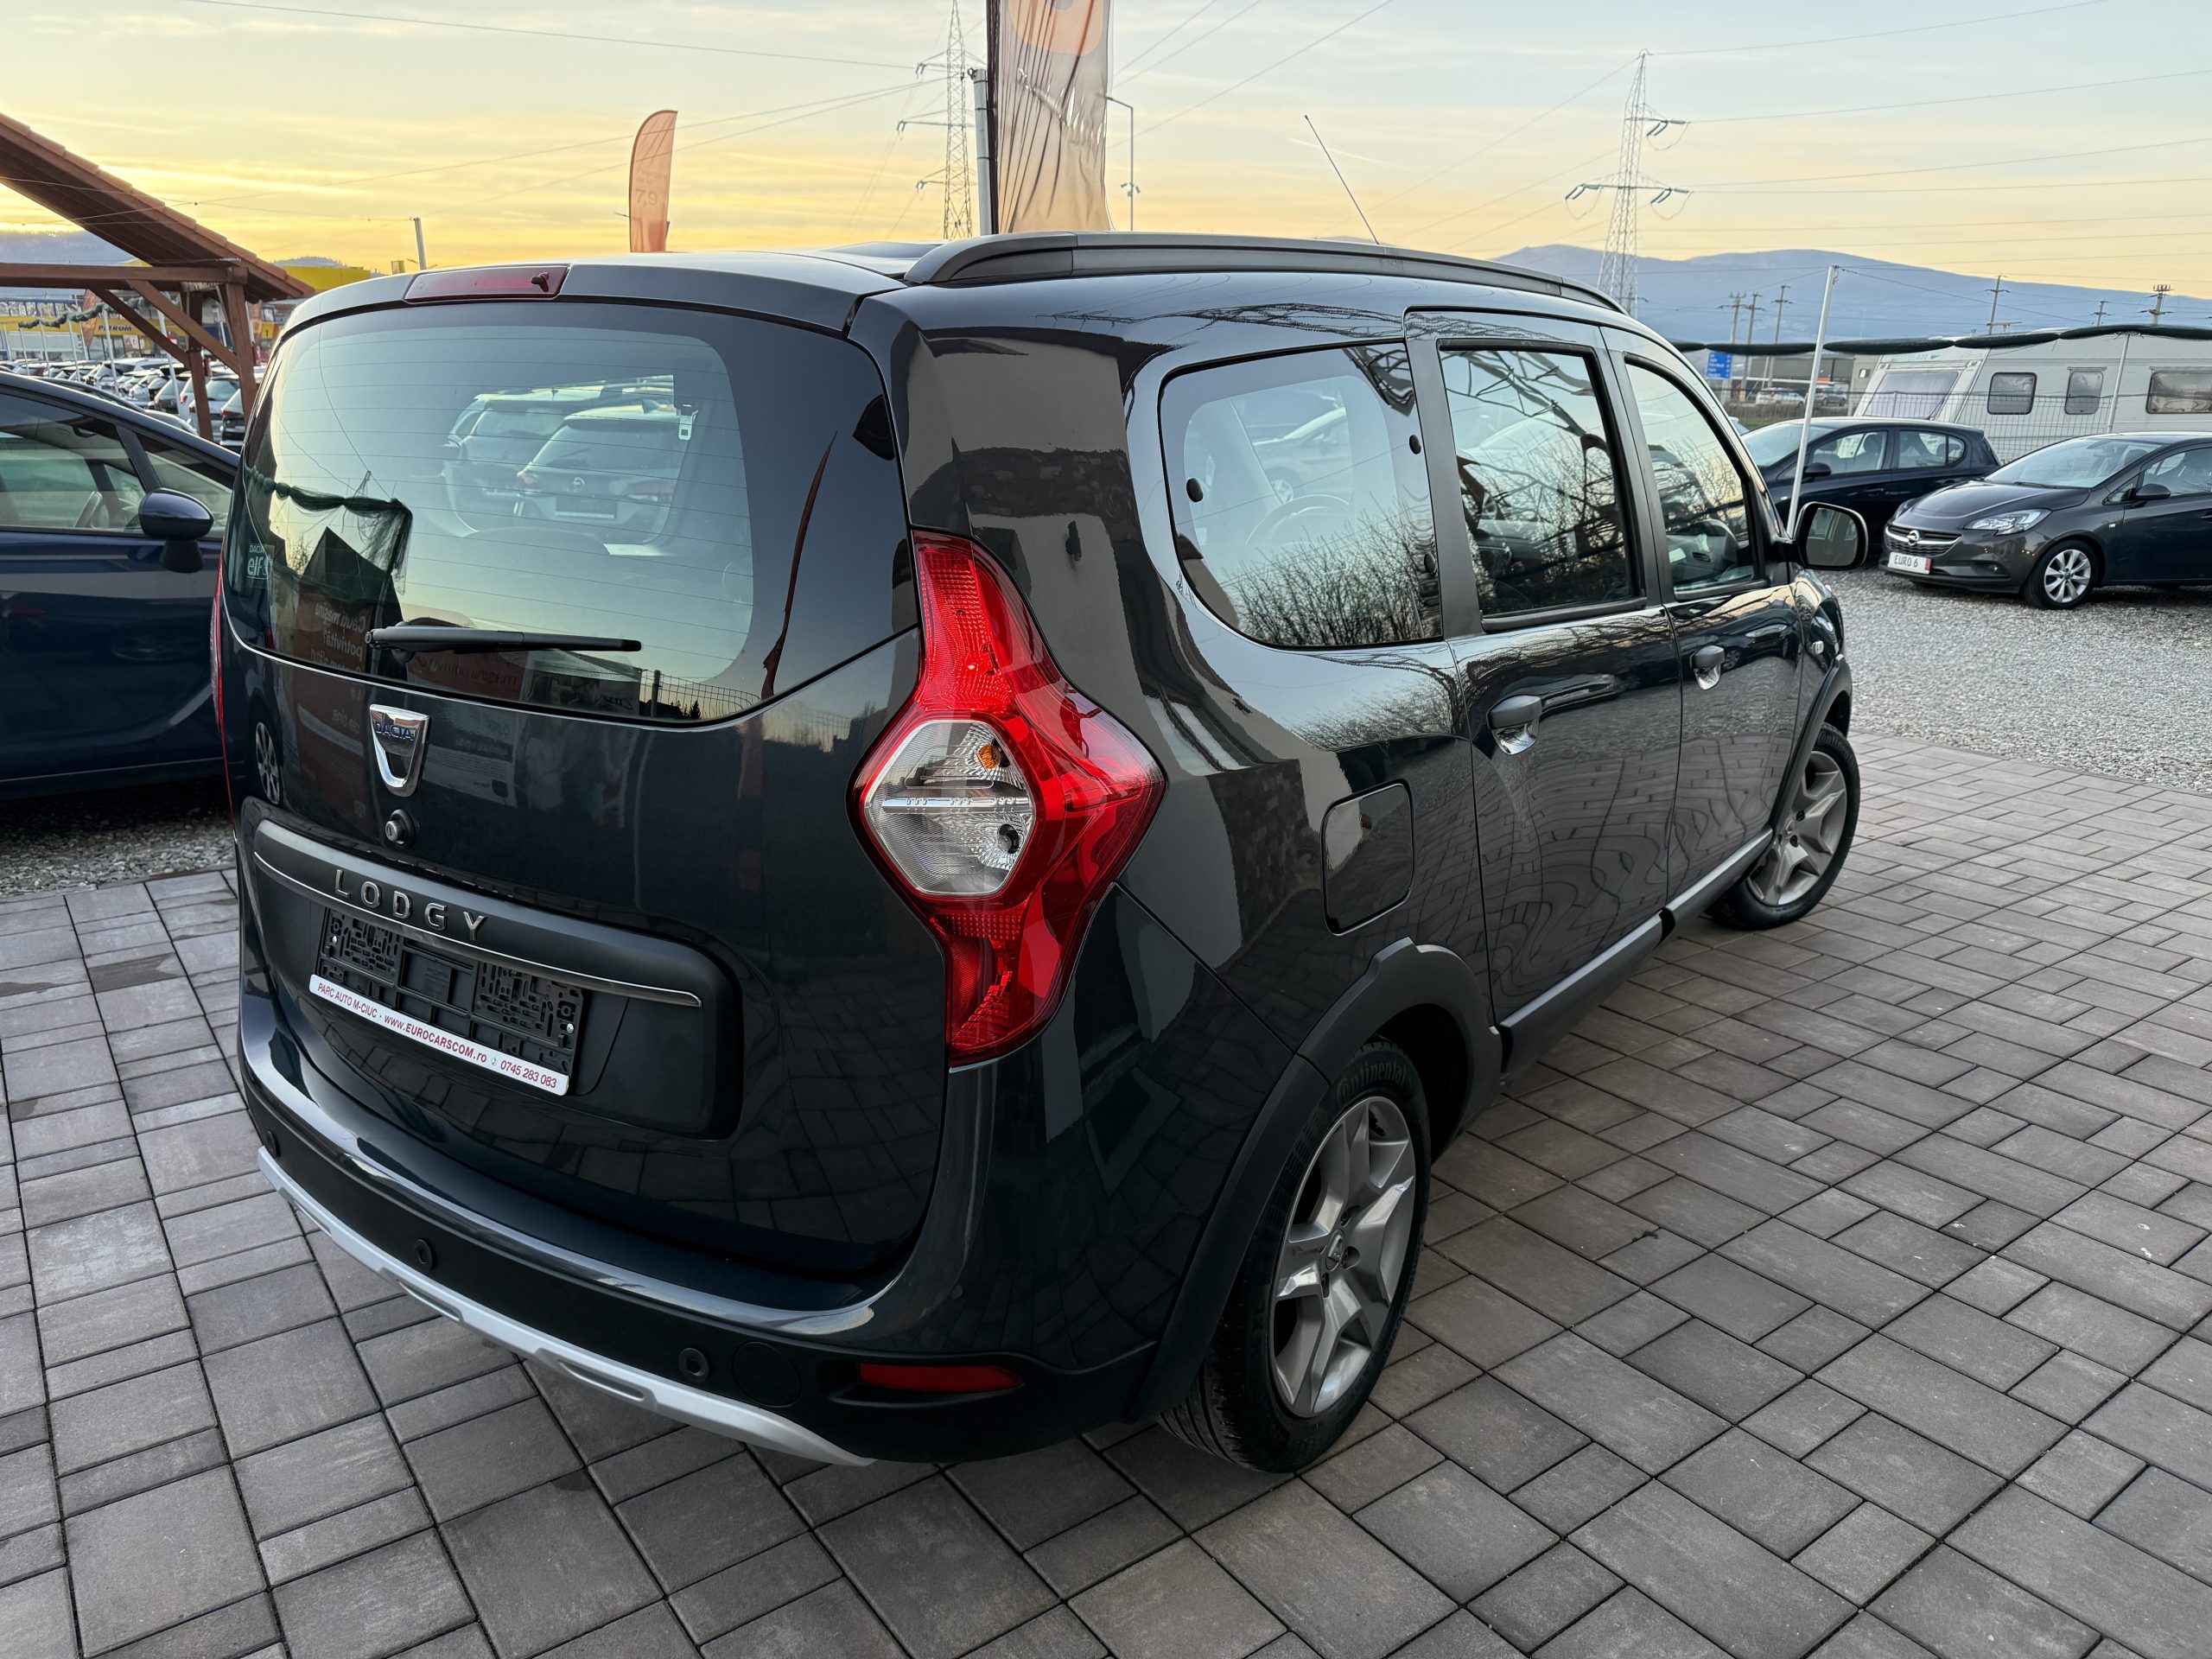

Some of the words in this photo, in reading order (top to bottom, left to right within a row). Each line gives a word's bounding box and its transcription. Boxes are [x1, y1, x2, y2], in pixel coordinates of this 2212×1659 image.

[1893, 554, 1912, 567] EURO
[1913, 558, 1918, 568] 6
[375, 720, 415, 741] DACIA
[334, 868, 487, 941] LODGY
[317, 982, 335, 997] PARC
[335, 991, 353, 1007] AUTO
[353, 999, 378, 1018] M-CIUC
[500, 1059, 522, 1075] 0745
[522, 1067, 539, 1082] 283
[540, 1074, 557, 1088] 083
